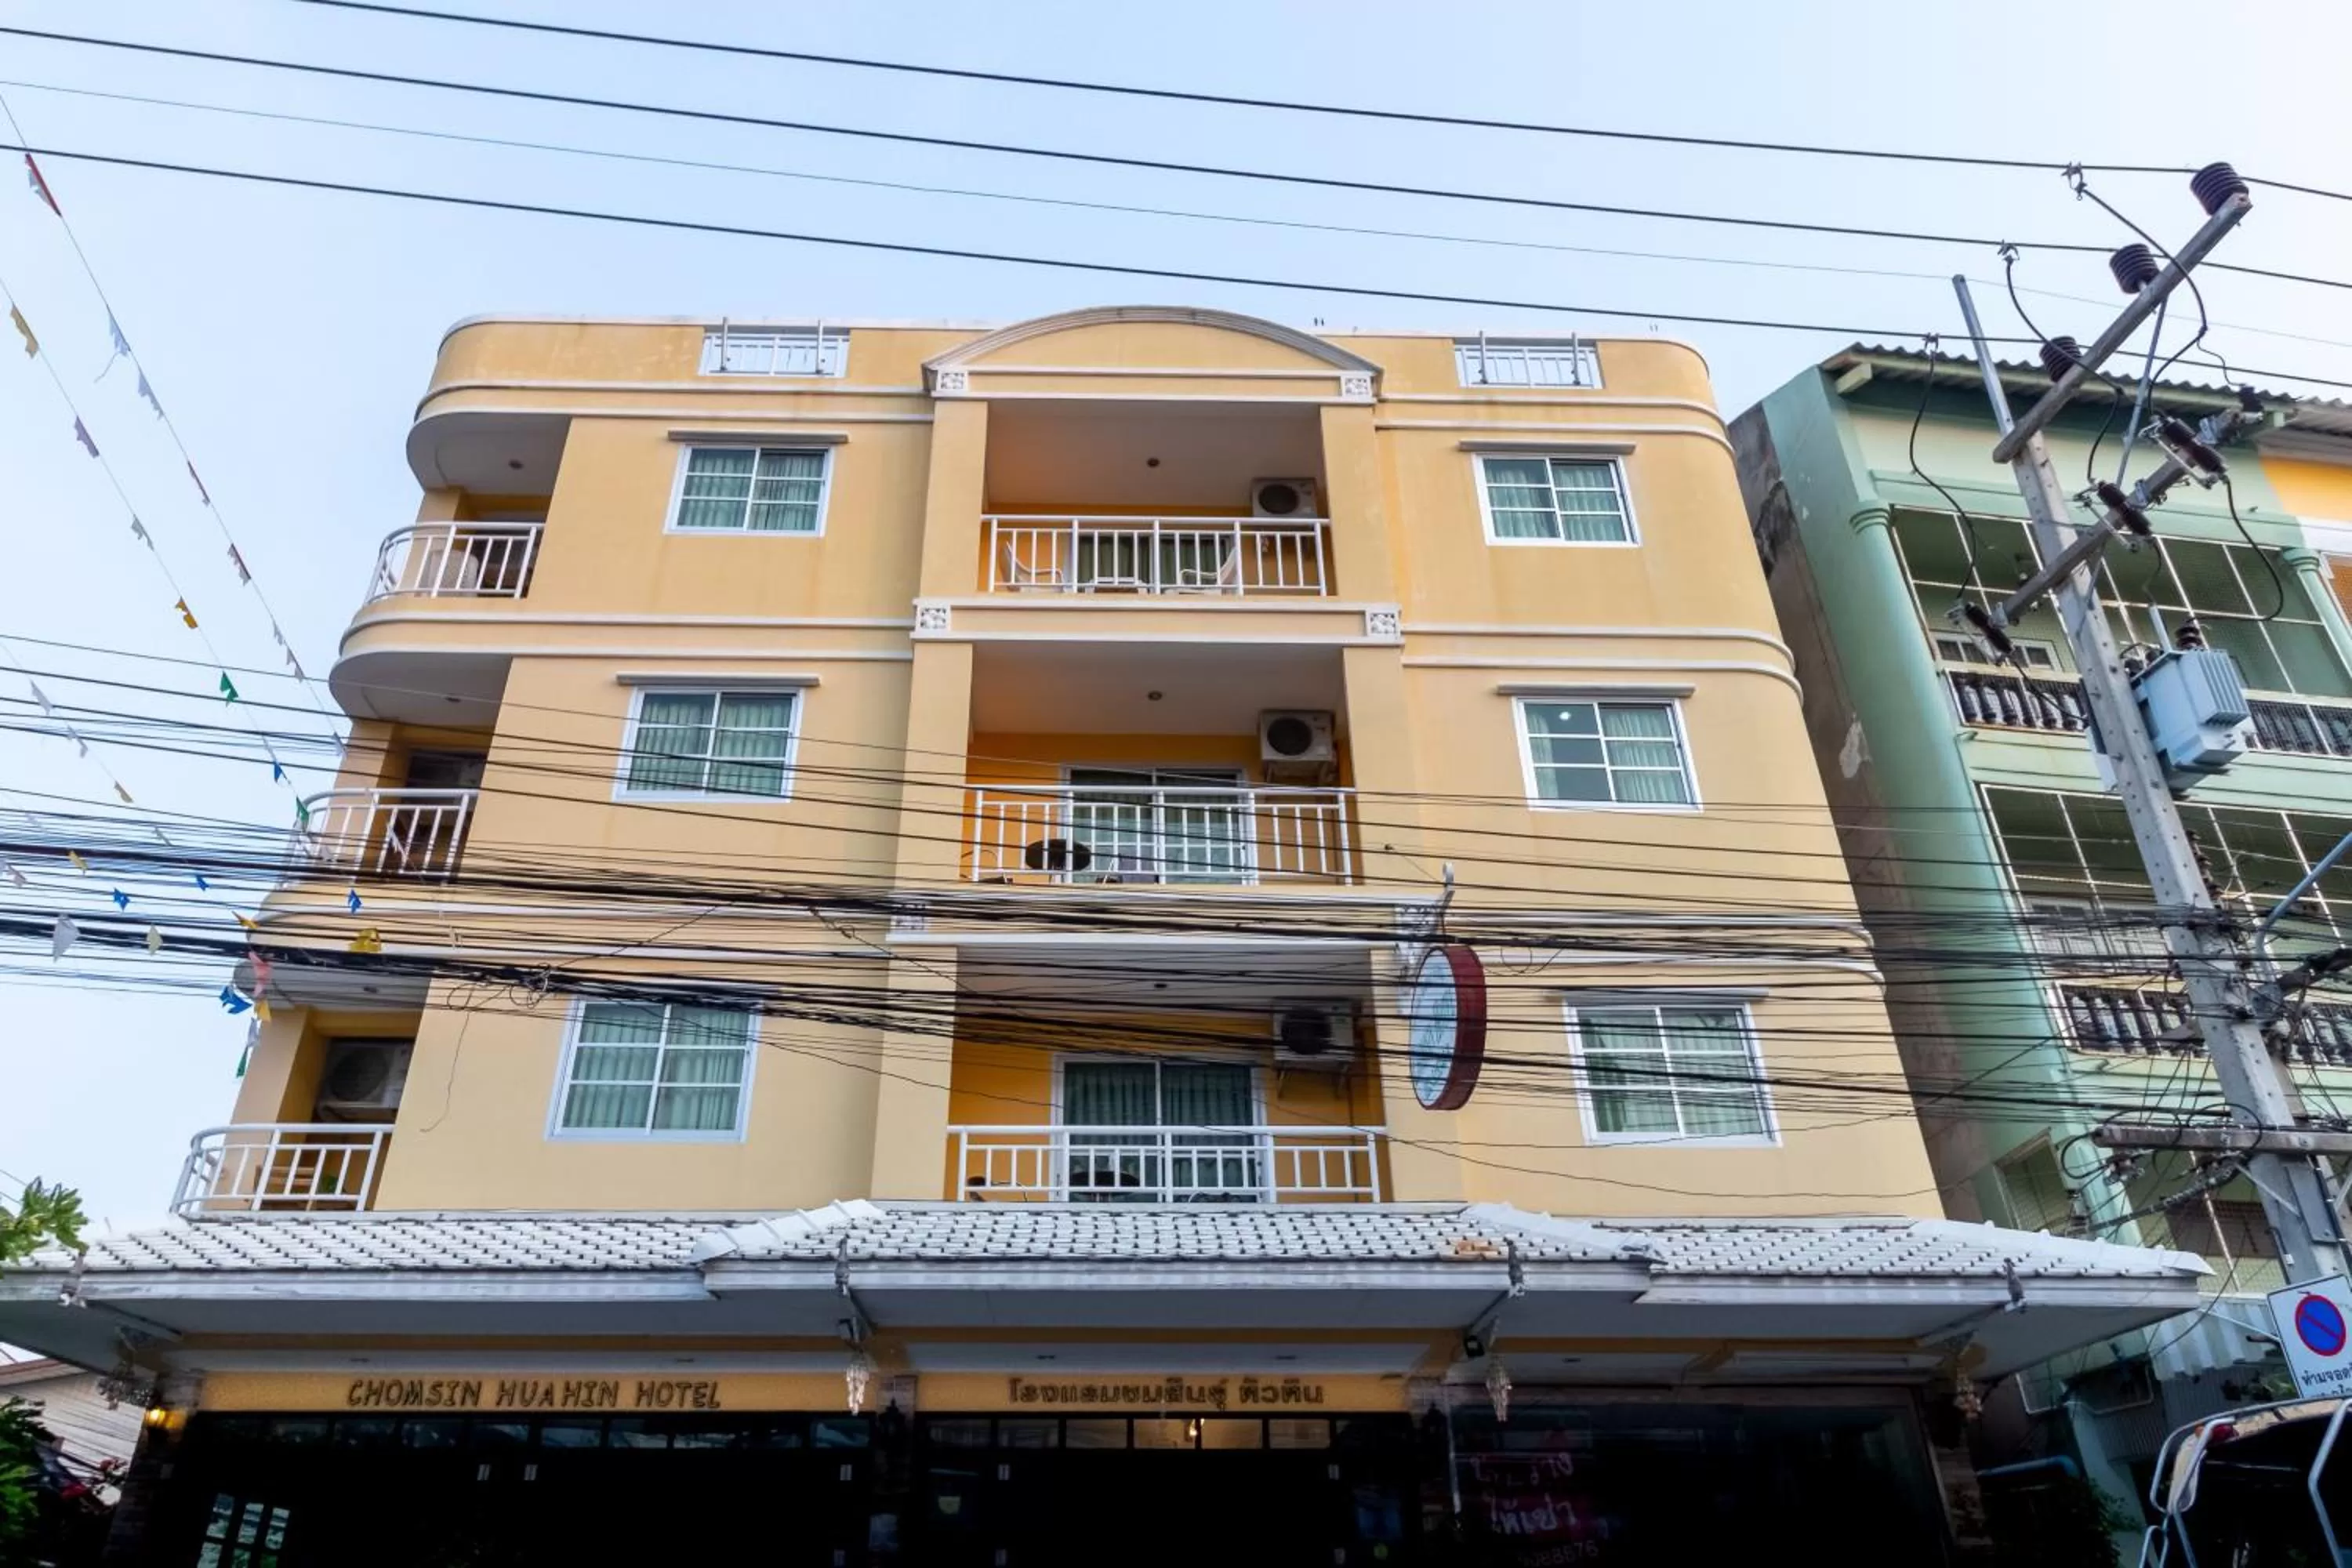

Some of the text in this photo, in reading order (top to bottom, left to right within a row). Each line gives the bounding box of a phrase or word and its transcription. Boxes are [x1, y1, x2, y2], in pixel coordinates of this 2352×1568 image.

[347, 1378, 721, 1409] CHOMSIN HUA HIN HOTEL
